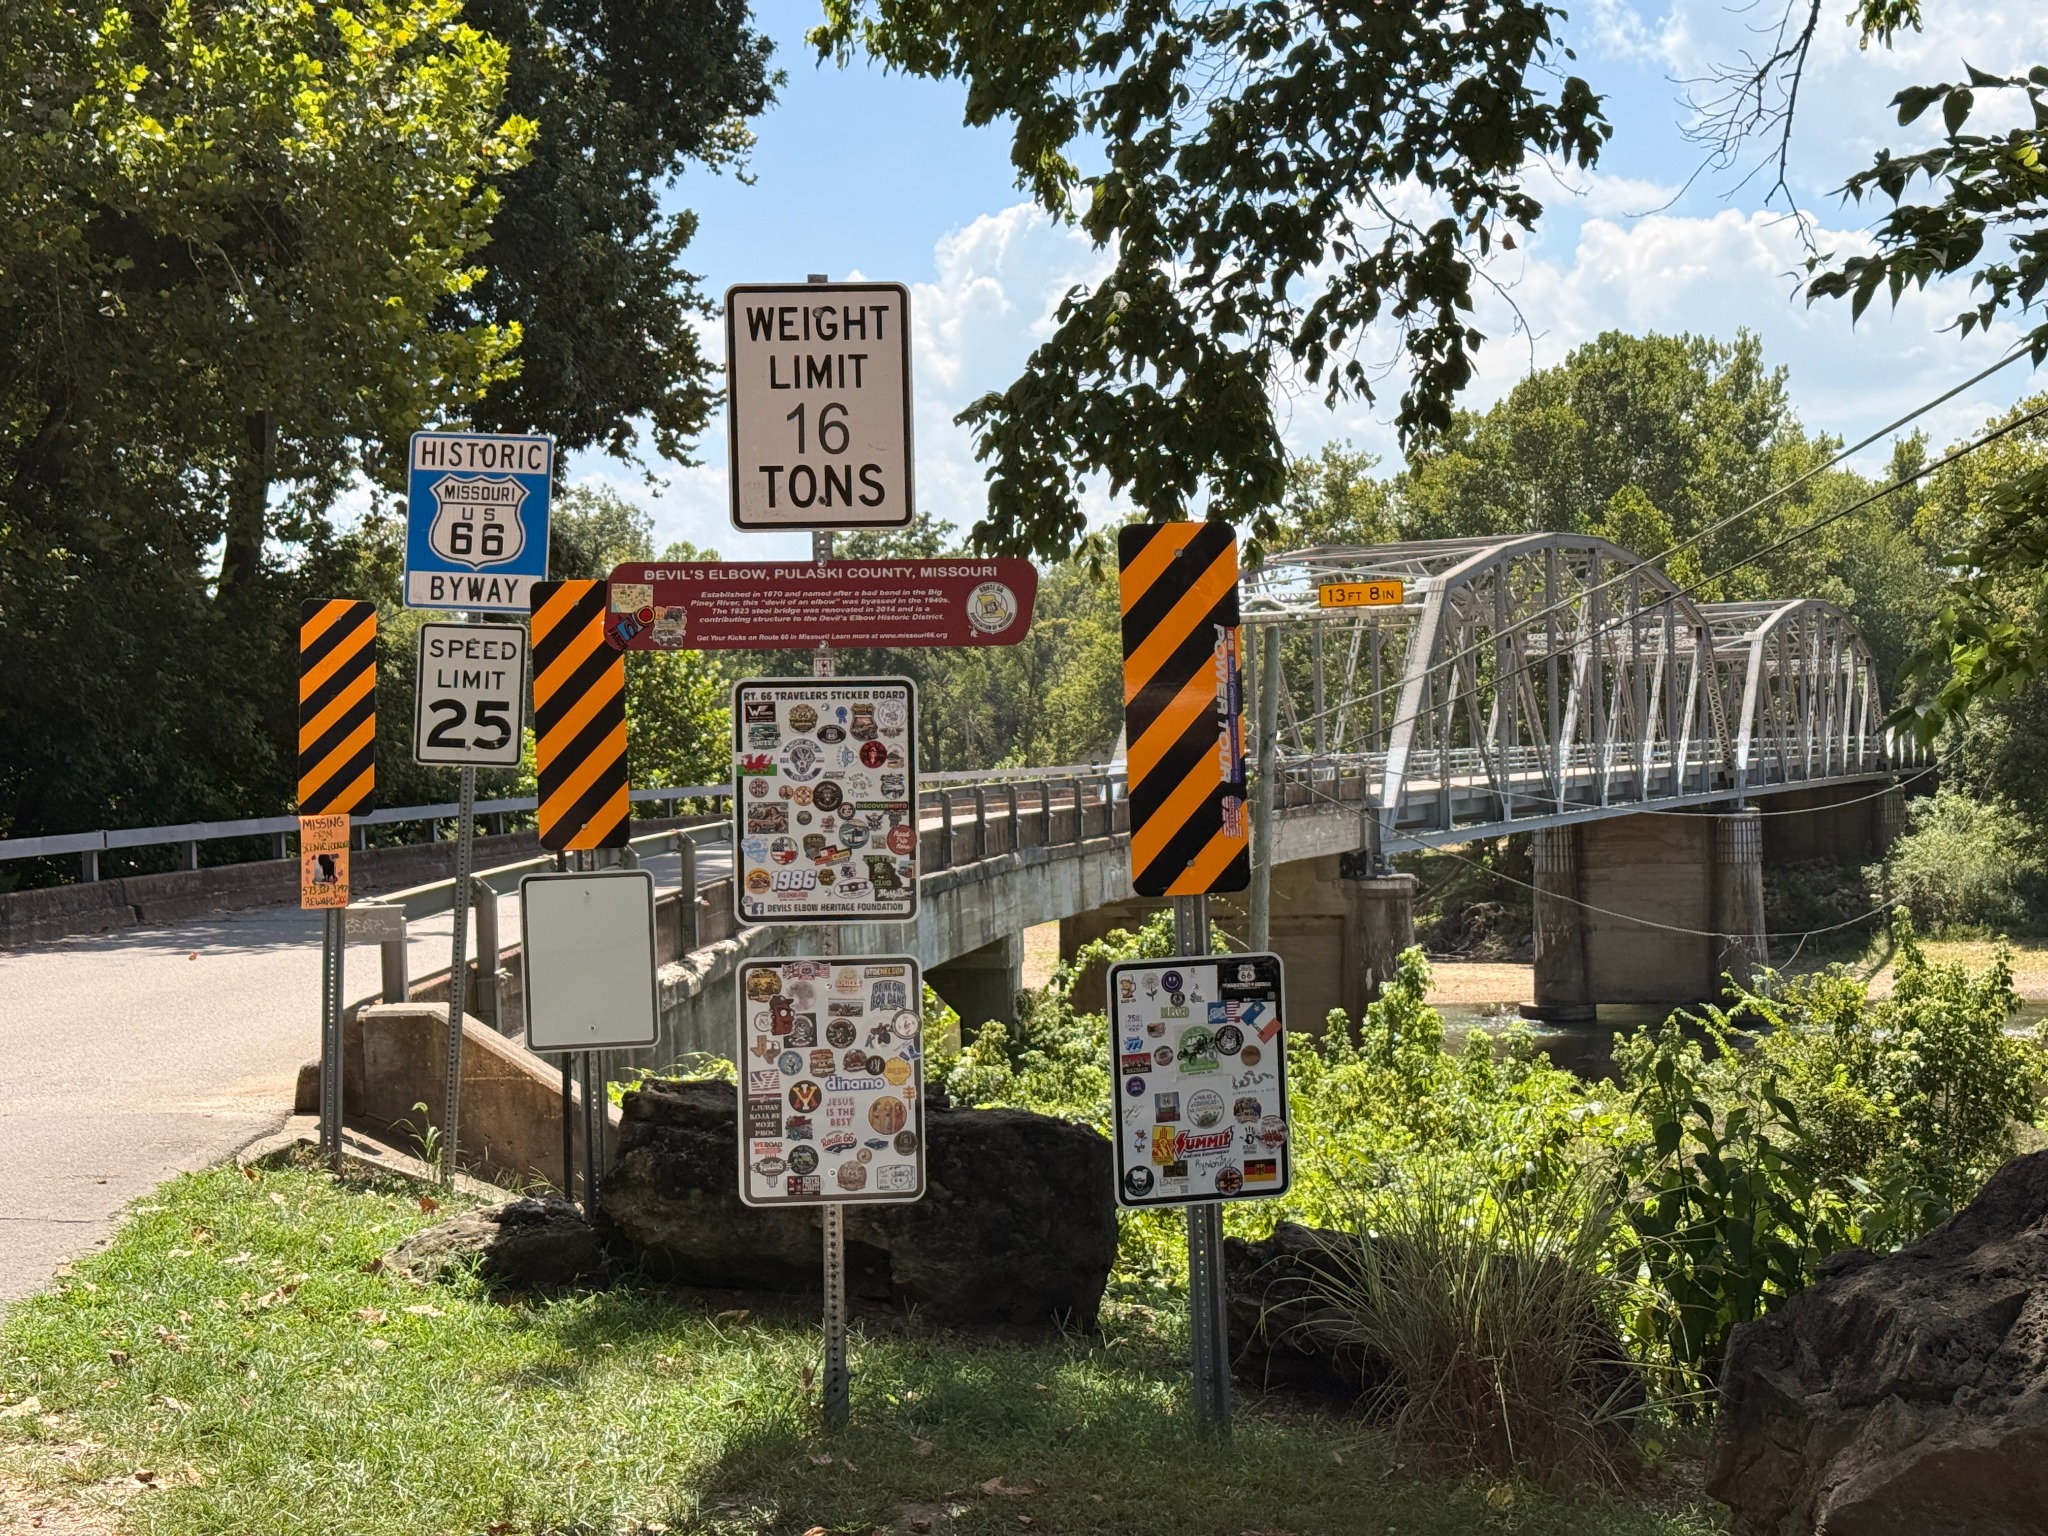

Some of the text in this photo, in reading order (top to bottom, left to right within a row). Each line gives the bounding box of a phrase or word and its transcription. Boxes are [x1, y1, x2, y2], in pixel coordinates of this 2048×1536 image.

[746, 305, 889, 341] WEIGHT
[769, 354, 868, 390] LIMIT
[786, 402, 850, 455] 16
[421, 440, 543, 470] HISTORIC
[444, 484, 517, 502] MISSOURI
[758, 463, 885, 508] TONS
[450, 522, 505, 556] 66
[643, 566, 998, 581] DEVIL'S ELBOW, PULASKI COUNTY, MISSOURI
[429, 575, 519, 604] BYWAY
[700, 591, 751, 599] Established
[763, 590, 783, 598] 1870
[784, 590, 801, 598] and
[861, 589, 878, 597] bad
[879, 589, 901, 597] bend
[912, 588, 926, 596] the
[927, 588, 943, 597] Big
[716, 599, 741, 607] River,
[860, 598, 896, 606] byassed
[751, 607, 772, 615] steel
[773, 607, 801, 615] bridge
[821, 606, 864, 614] renovated
[699, 616, 751, 624] contributing
[911, 613, 945, 621] District.
[759, 633, 779, 641] Route
[831, 632, 851, 640] Learn
[879, 632, 948, 640] www.missouri66.org
[429, 638, 518, 661] SPEED
[1213, 623, 1229, 715] POWER
[436, 668, 506, 691] LIMIT
[743, 689, 905, 701] RT. 66 TRAVELERS STICKER BOARD
[426, 698, 512, 751] 25
[1217, 719, 1232, 784] TOUR
[302, 815, 345, 831] MISSING
[771, 869, 818, 892] 1986
[304, 896, 336, 907] REWARD
[767, 902, 904, 913] DEVILS ELBOW HERITAGE FOUNDATION
[1240, 971, 1253, 980] 66
[873, 993, 886, 1007] FOR
[826, 1075, 884, 1091] dinamo
[826, 1097, 855, 1106] JESUS
[837, 1107, 855, 1116] THE
[830, 1118, 853, 1126] BEST
[821, 1134, 843, 1148] Route
[843, 1132, 855, 1143] 66
